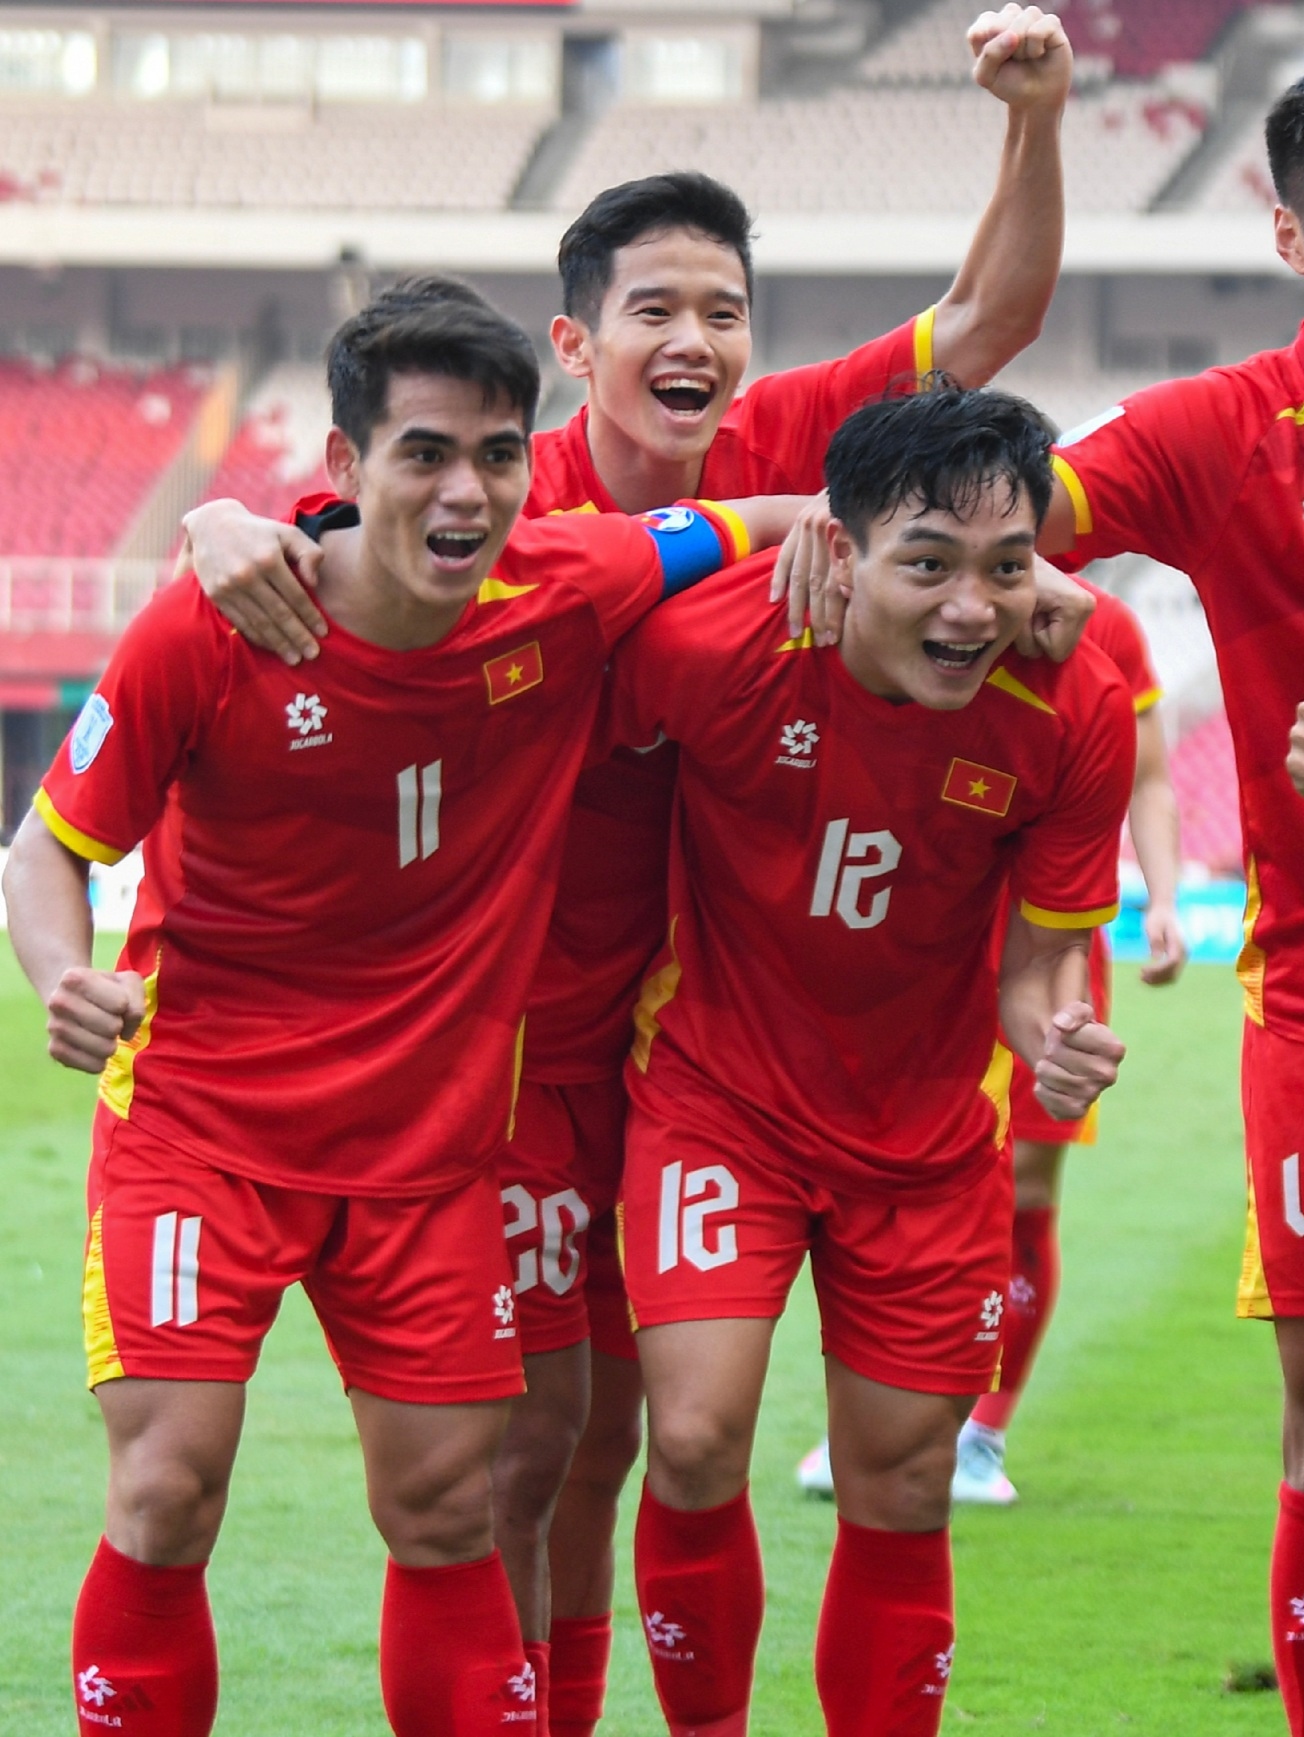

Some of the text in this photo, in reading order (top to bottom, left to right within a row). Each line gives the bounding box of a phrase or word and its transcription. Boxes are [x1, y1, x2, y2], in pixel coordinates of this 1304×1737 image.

[397, 759, 442, 869] 11
[810, 819, 901, 928] 12
[151, 1211, 202, 1328] 11
[501, 1184, 590, 1296] 20
[658, 1161, 739, 1274] 12
